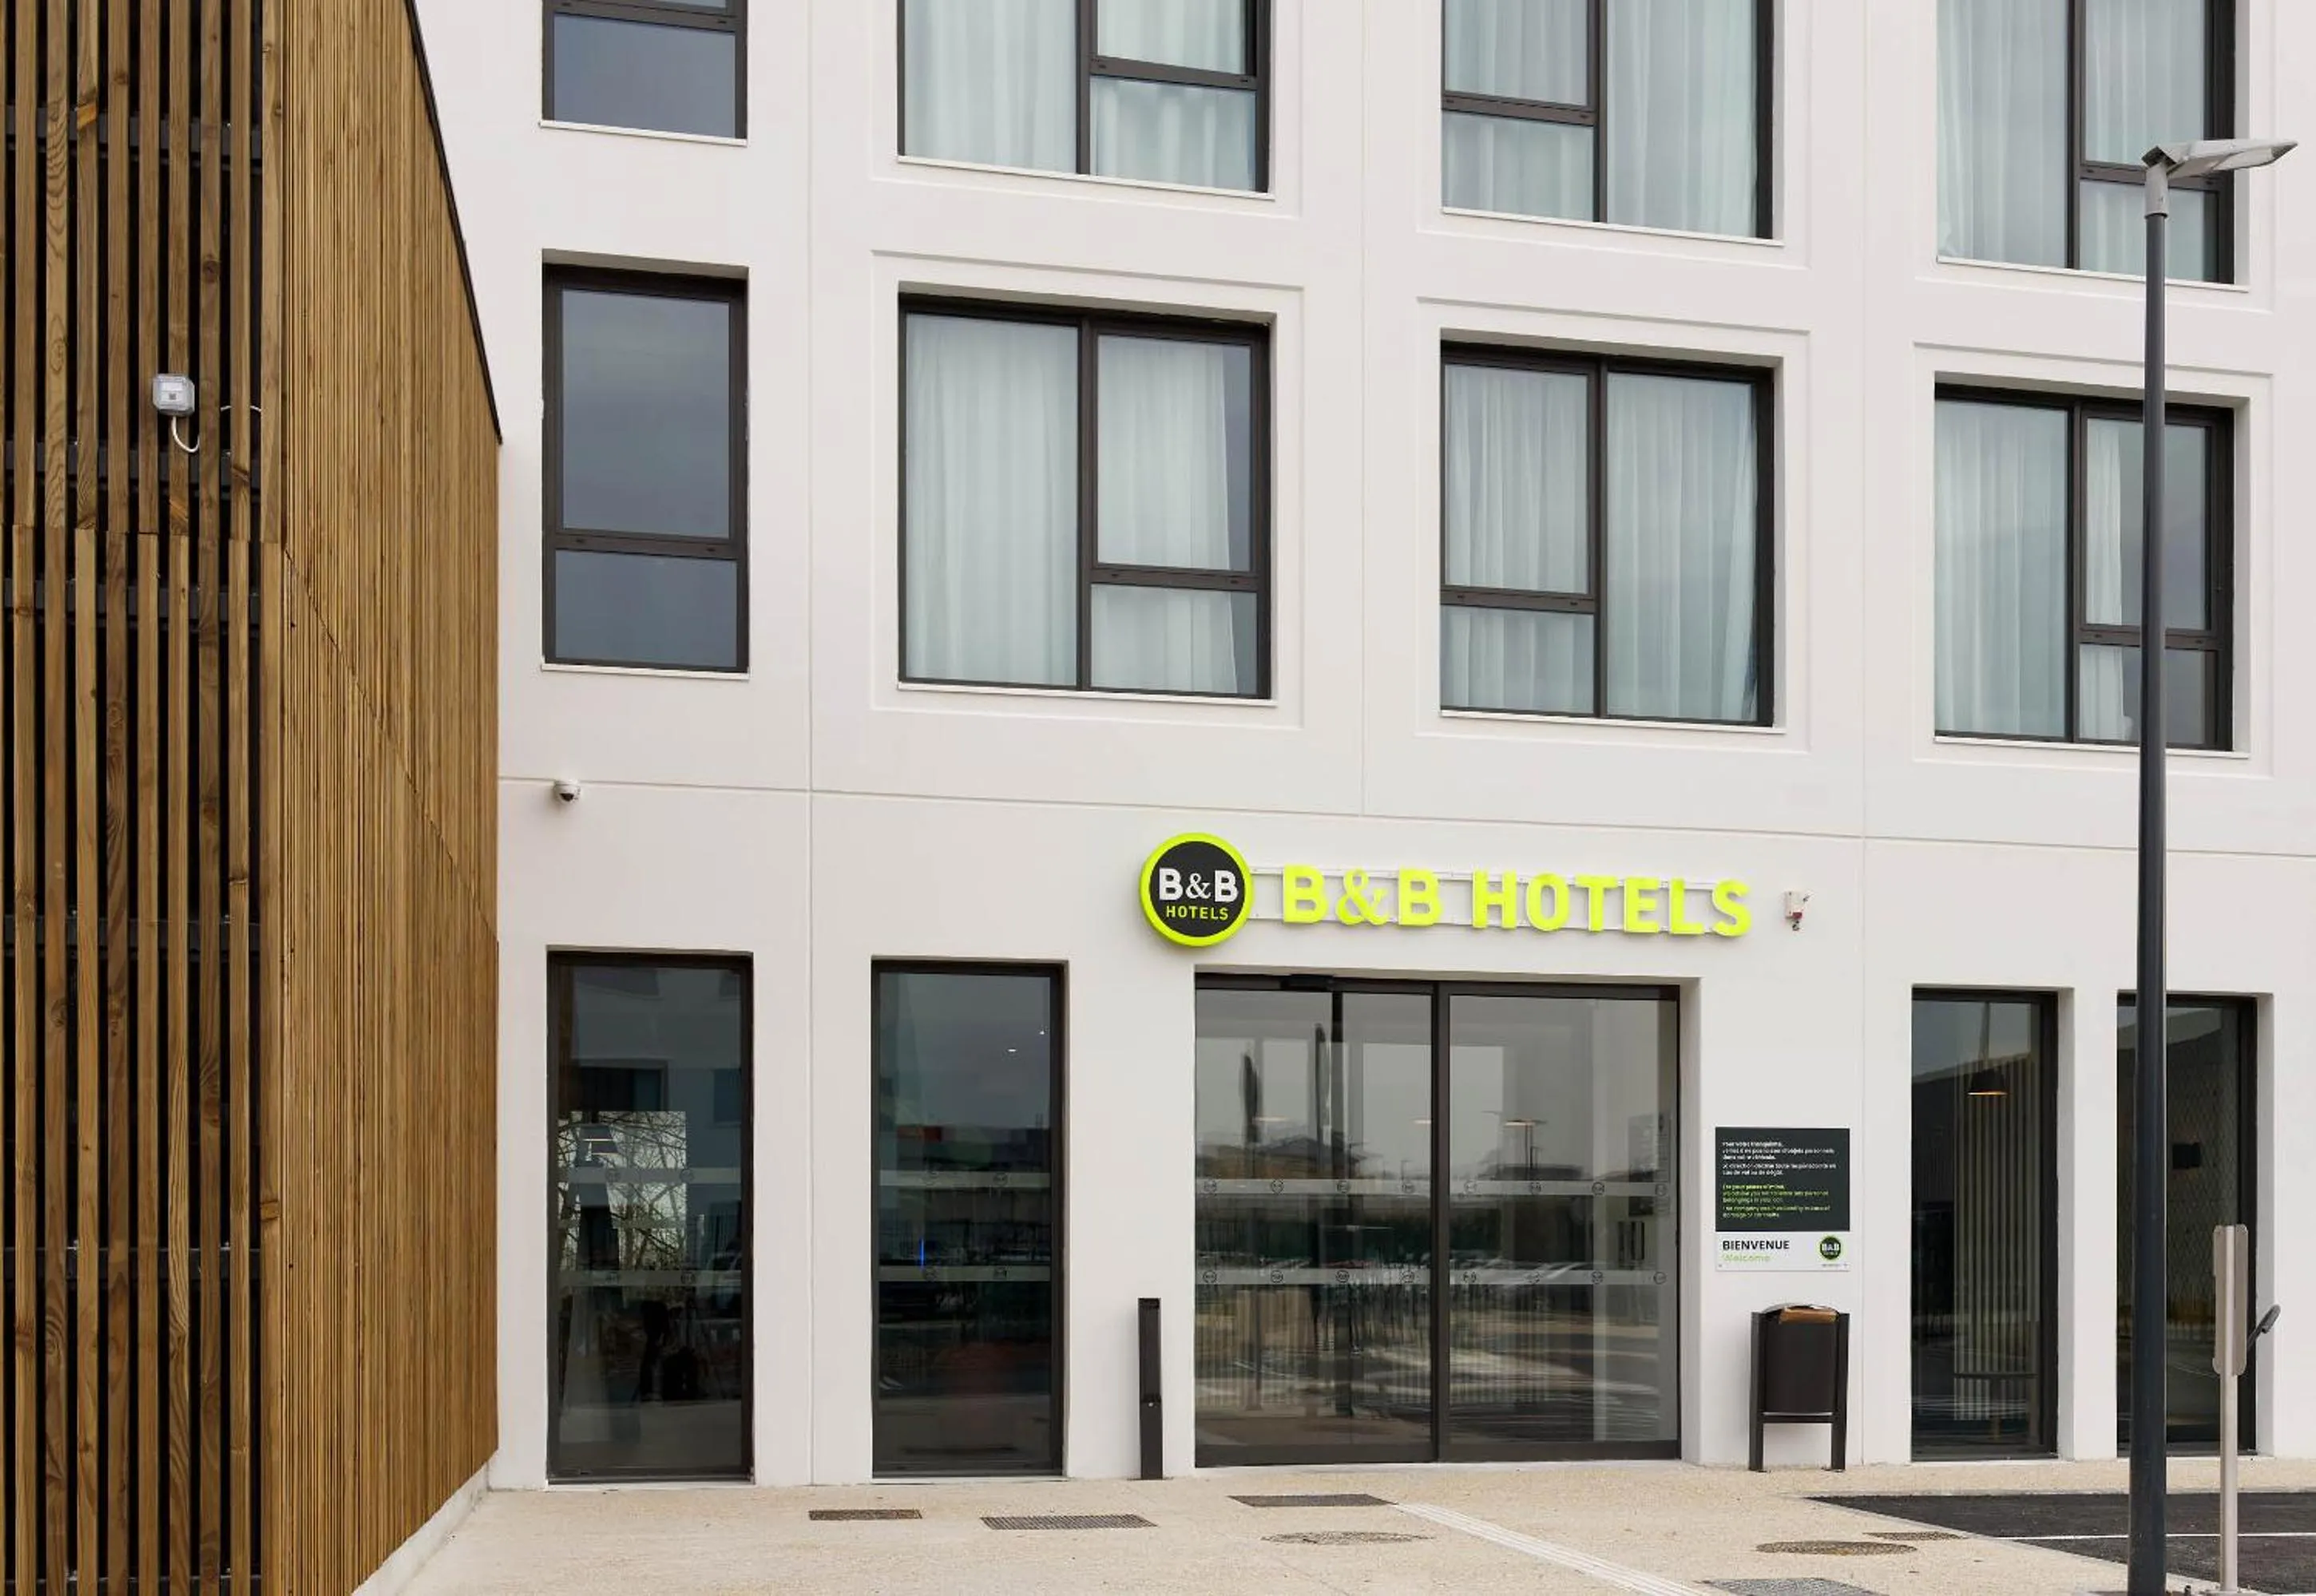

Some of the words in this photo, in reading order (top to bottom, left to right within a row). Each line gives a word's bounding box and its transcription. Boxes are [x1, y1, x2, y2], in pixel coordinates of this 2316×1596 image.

[1159, 867, 1239, 902] B&B
[1166, 905, 1228, 921] HOTELS
[1282, 864, 1443, 926] B&B
[1471, 869, 1753, 938] HOTELS
[1723, 1241, 1790, 1250] BIENVENUE
